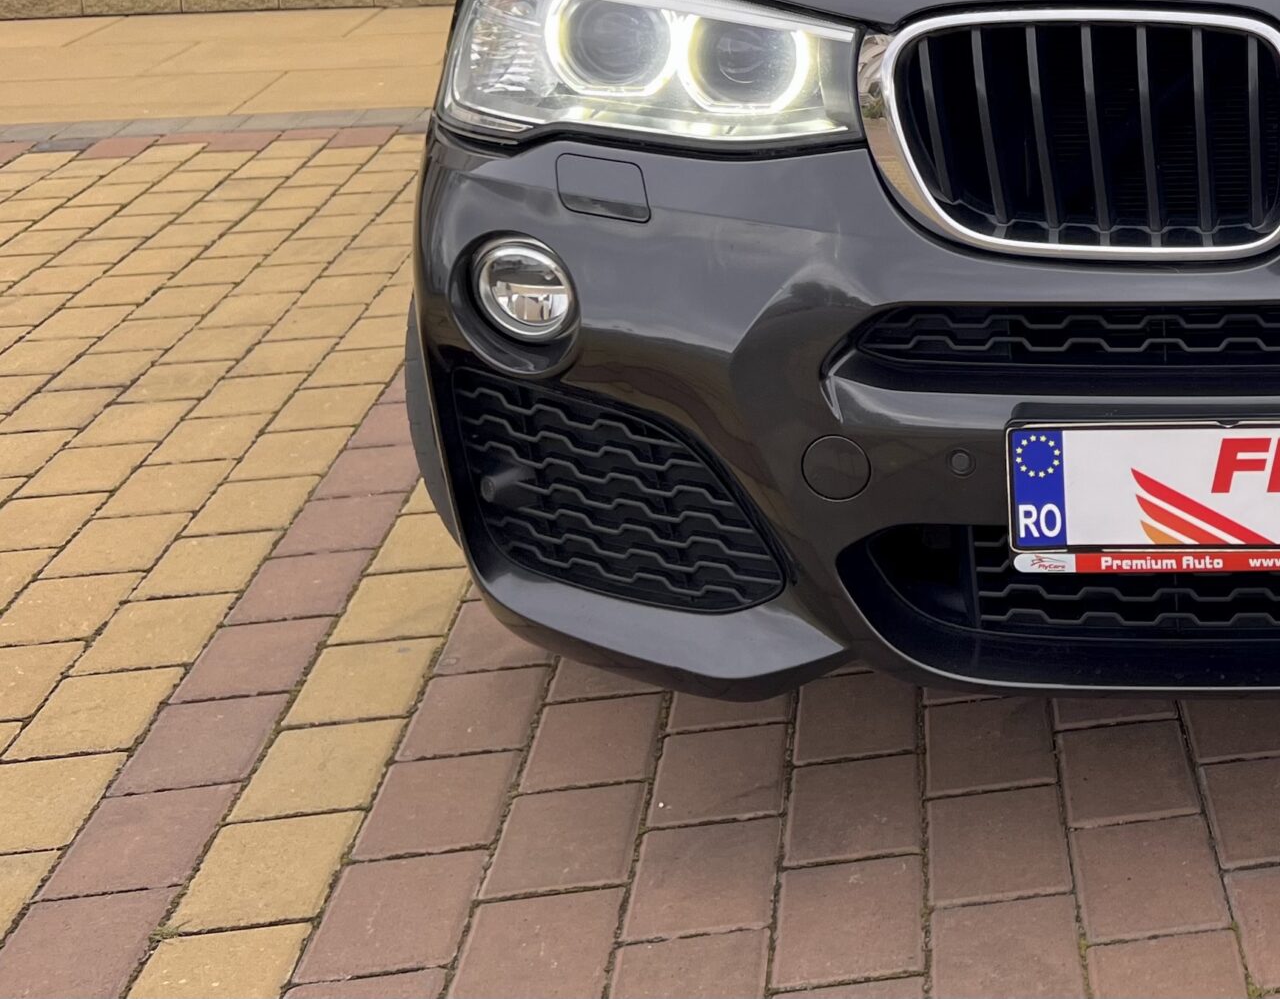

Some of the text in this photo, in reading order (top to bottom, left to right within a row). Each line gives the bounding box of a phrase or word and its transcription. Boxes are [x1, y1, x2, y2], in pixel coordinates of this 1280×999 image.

[1018, 503, 1062, 538] RO
[1100, 556, 1177, 570] Premium
[1182, 555, 1223, 569] Auto
